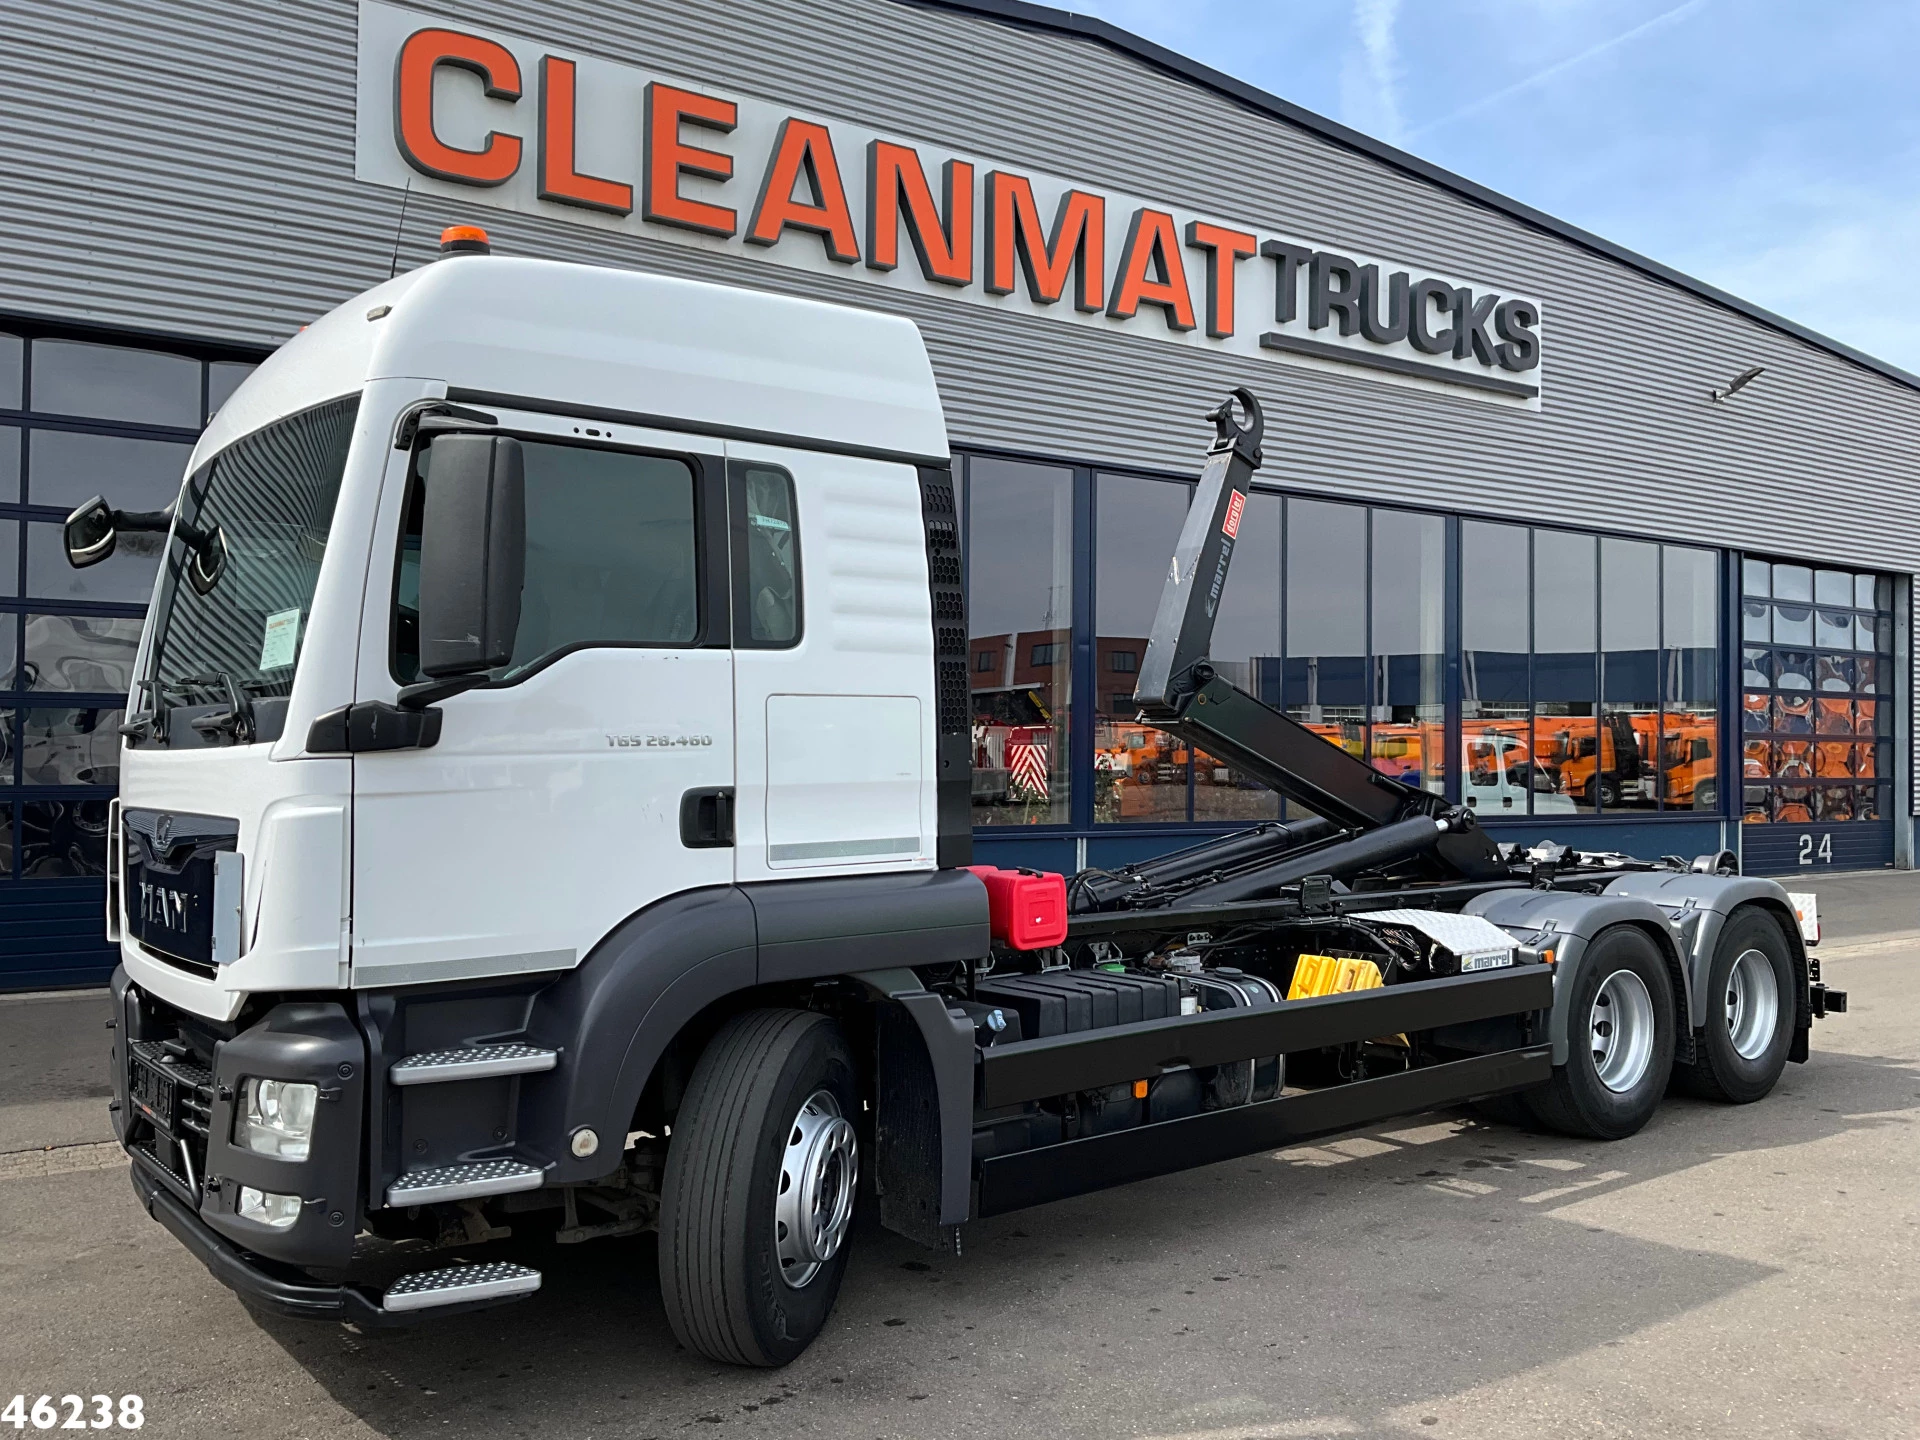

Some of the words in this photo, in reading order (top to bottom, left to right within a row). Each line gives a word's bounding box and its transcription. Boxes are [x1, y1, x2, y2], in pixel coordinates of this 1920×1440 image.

[393, 27, 1257, 339] CLEANMAT
[1260, 239, 1540, 372] TRUCKS
[1210, 538, 1231, 599] marrel
[605, 734, 642, 747] TGS
[646, 734, 713, 747] 28.460
[1799, 833, 1833, 865] 24
[1474, 949, 1510, 969] marrel
